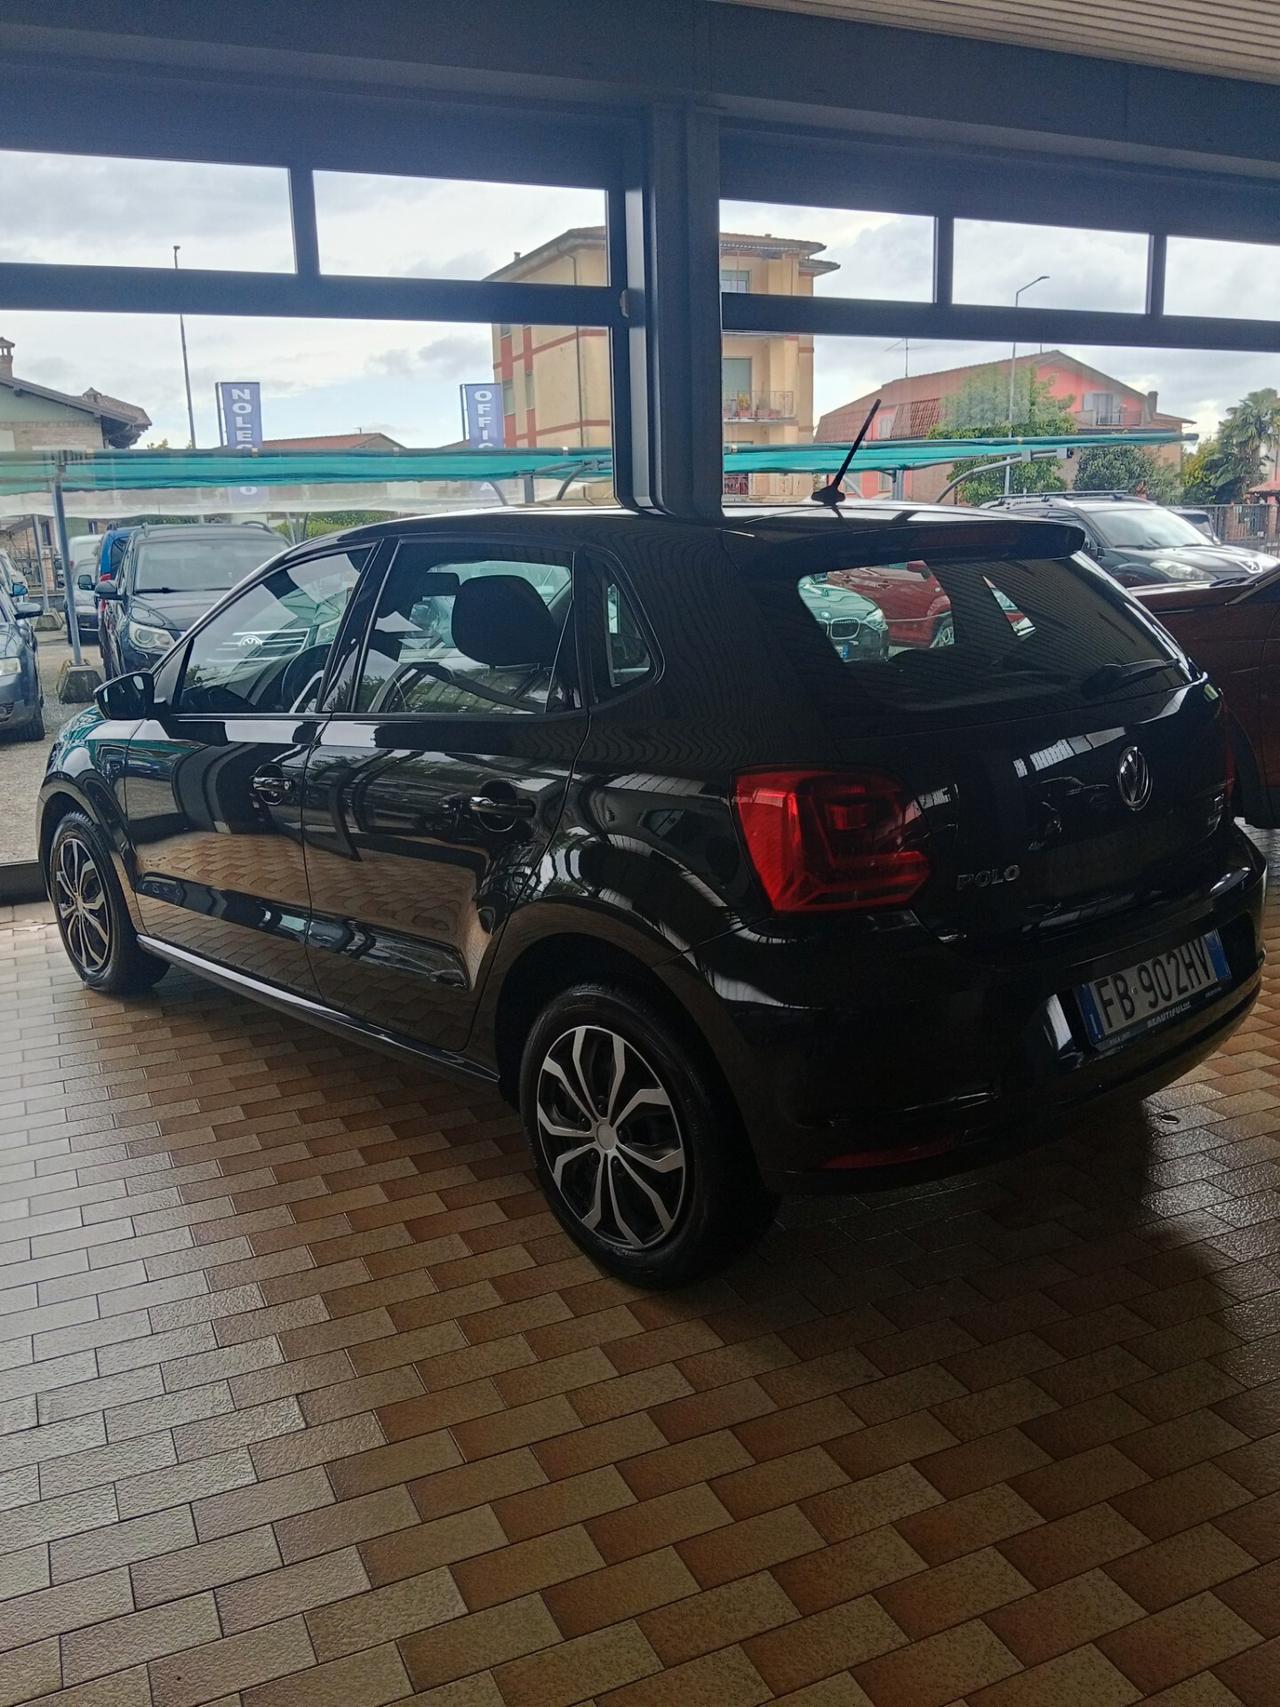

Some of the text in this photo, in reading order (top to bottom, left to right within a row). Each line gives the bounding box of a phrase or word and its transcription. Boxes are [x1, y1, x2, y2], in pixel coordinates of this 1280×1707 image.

[956, 864, 1021, 891] POLO
[1094, 936, 1211, 1028] FB 902HV
